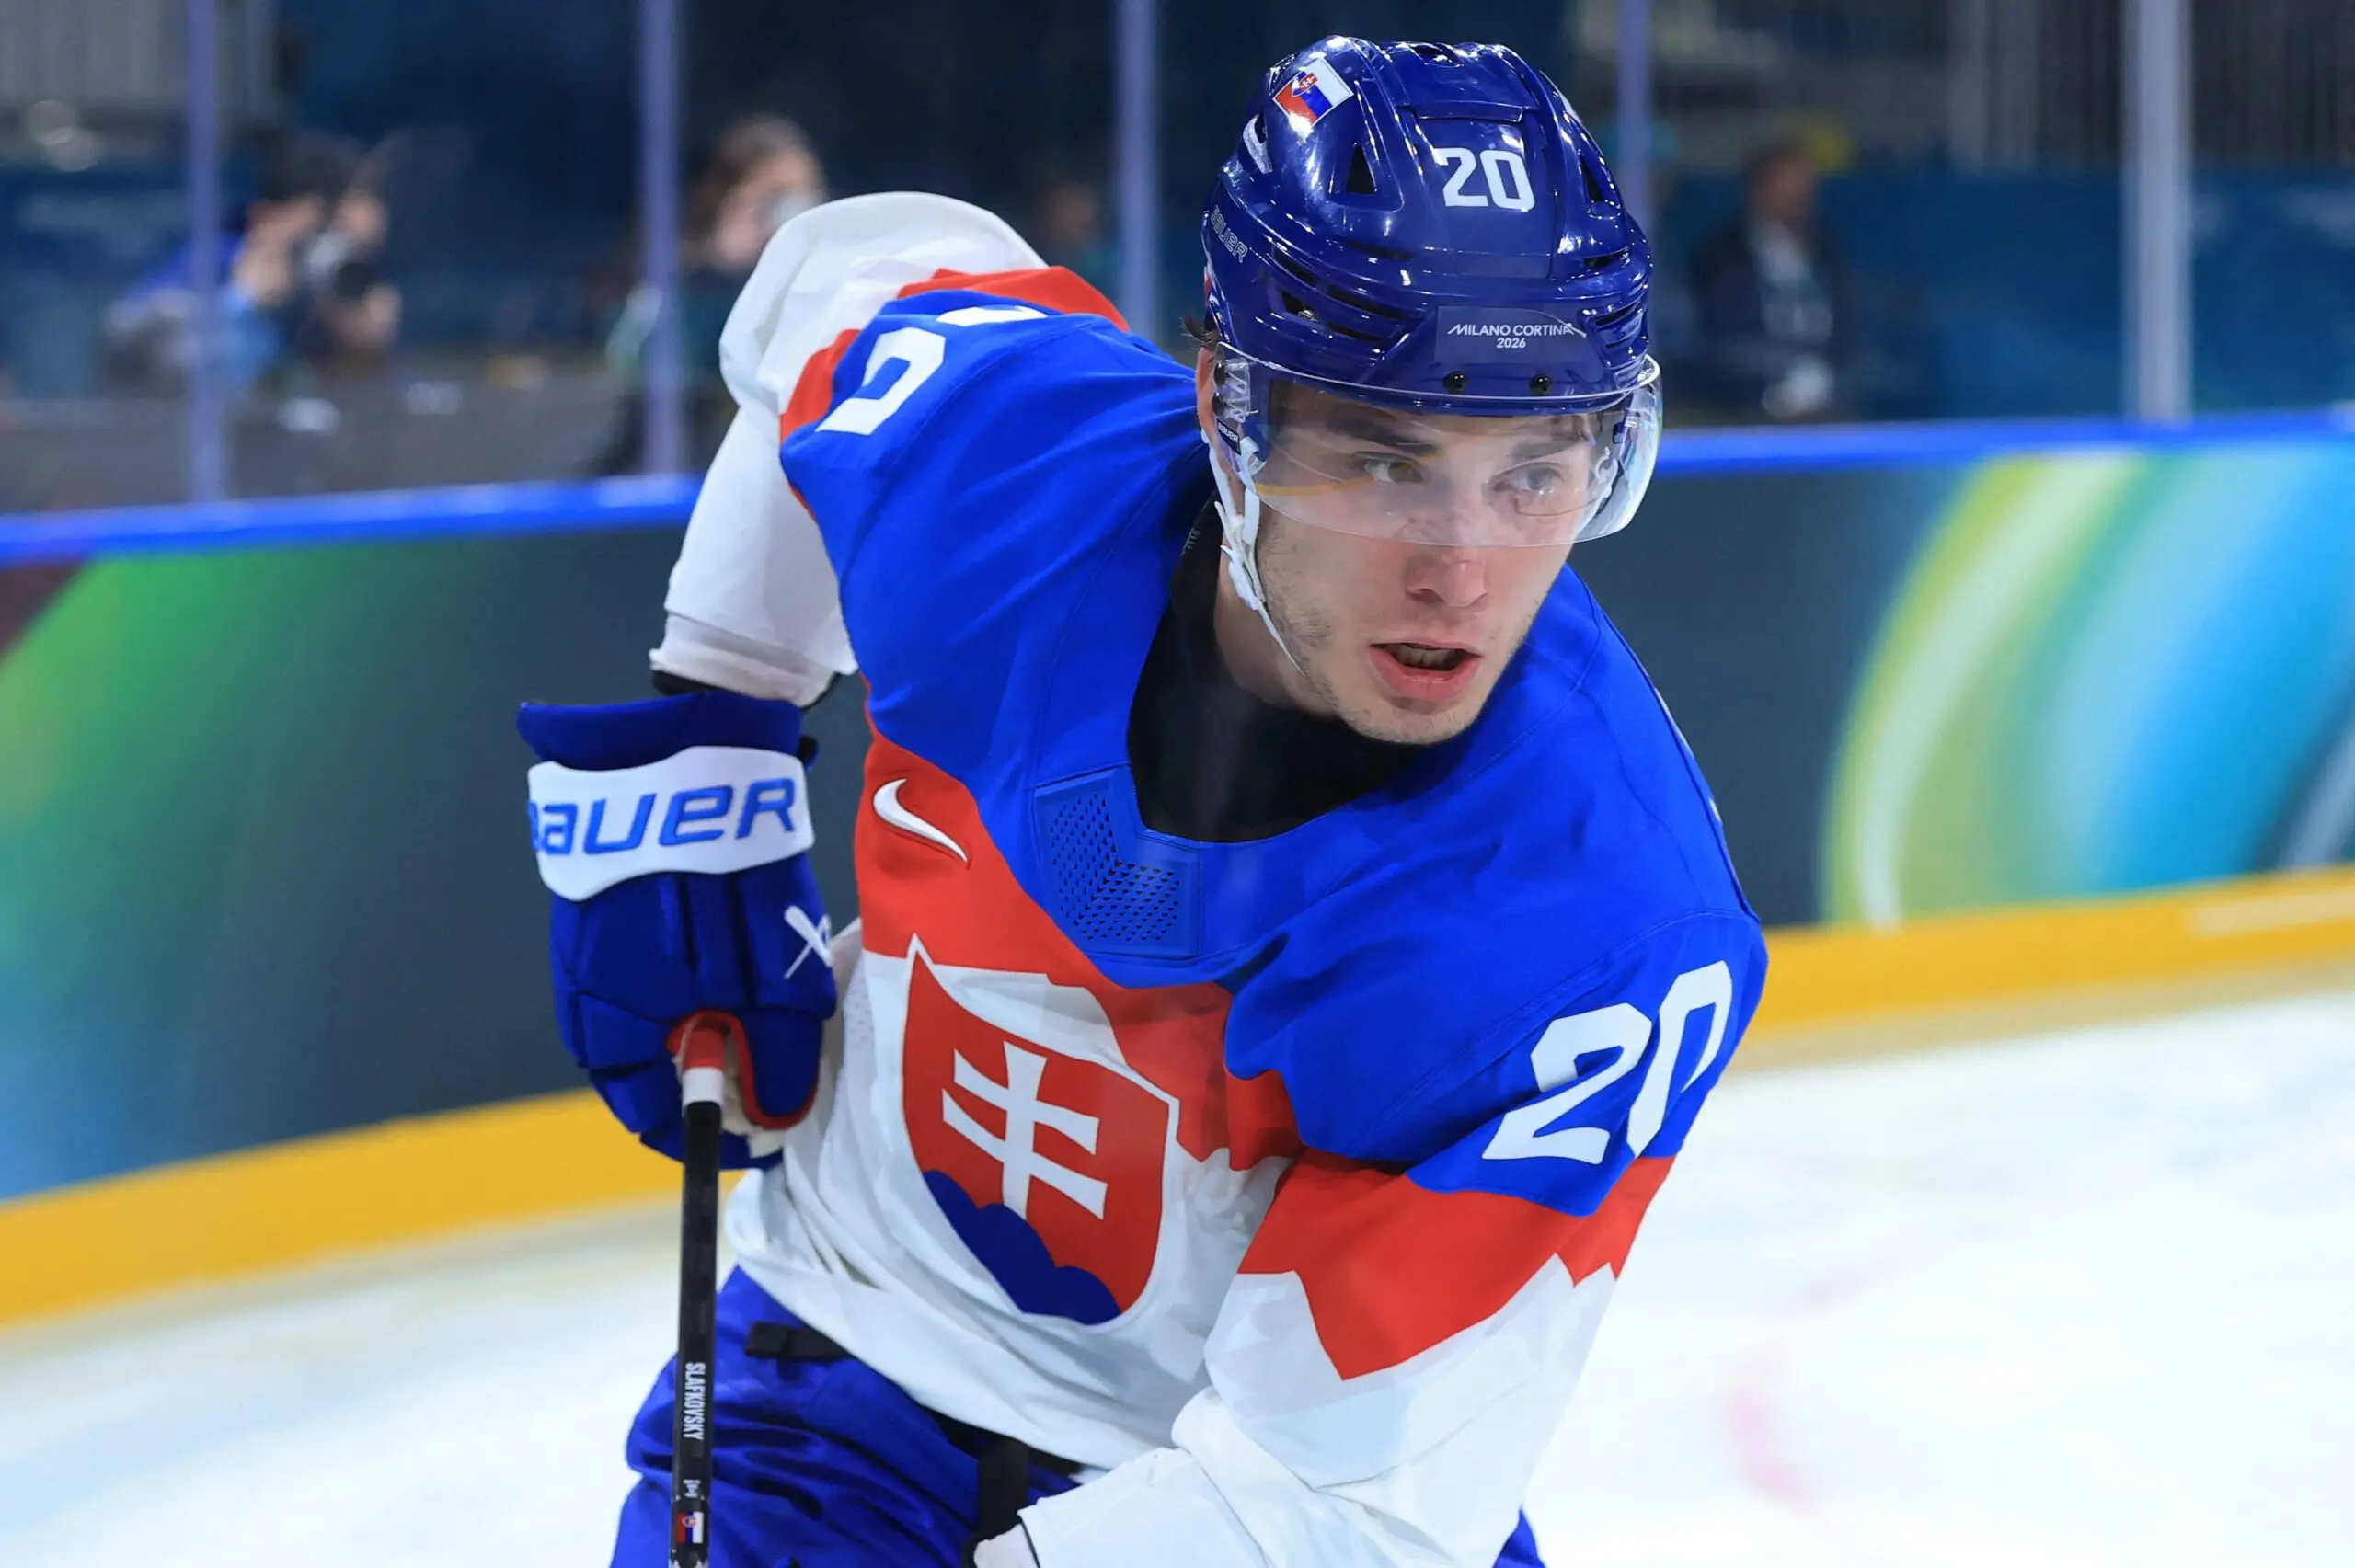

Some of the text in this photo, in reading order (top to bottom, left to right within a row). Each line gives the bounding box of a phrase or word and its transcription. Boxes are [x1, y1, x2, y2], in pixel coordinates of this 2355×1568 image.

[1431, 147, 1535, 212] 20
[1447, 324, 1575, 336] MILANO CORTINA
[1496, 338, 1527, 349] 2026
[1481, 959, 1733, 1165] 20
[683, 1362, 706, 1440] SLAFKOVSKY
